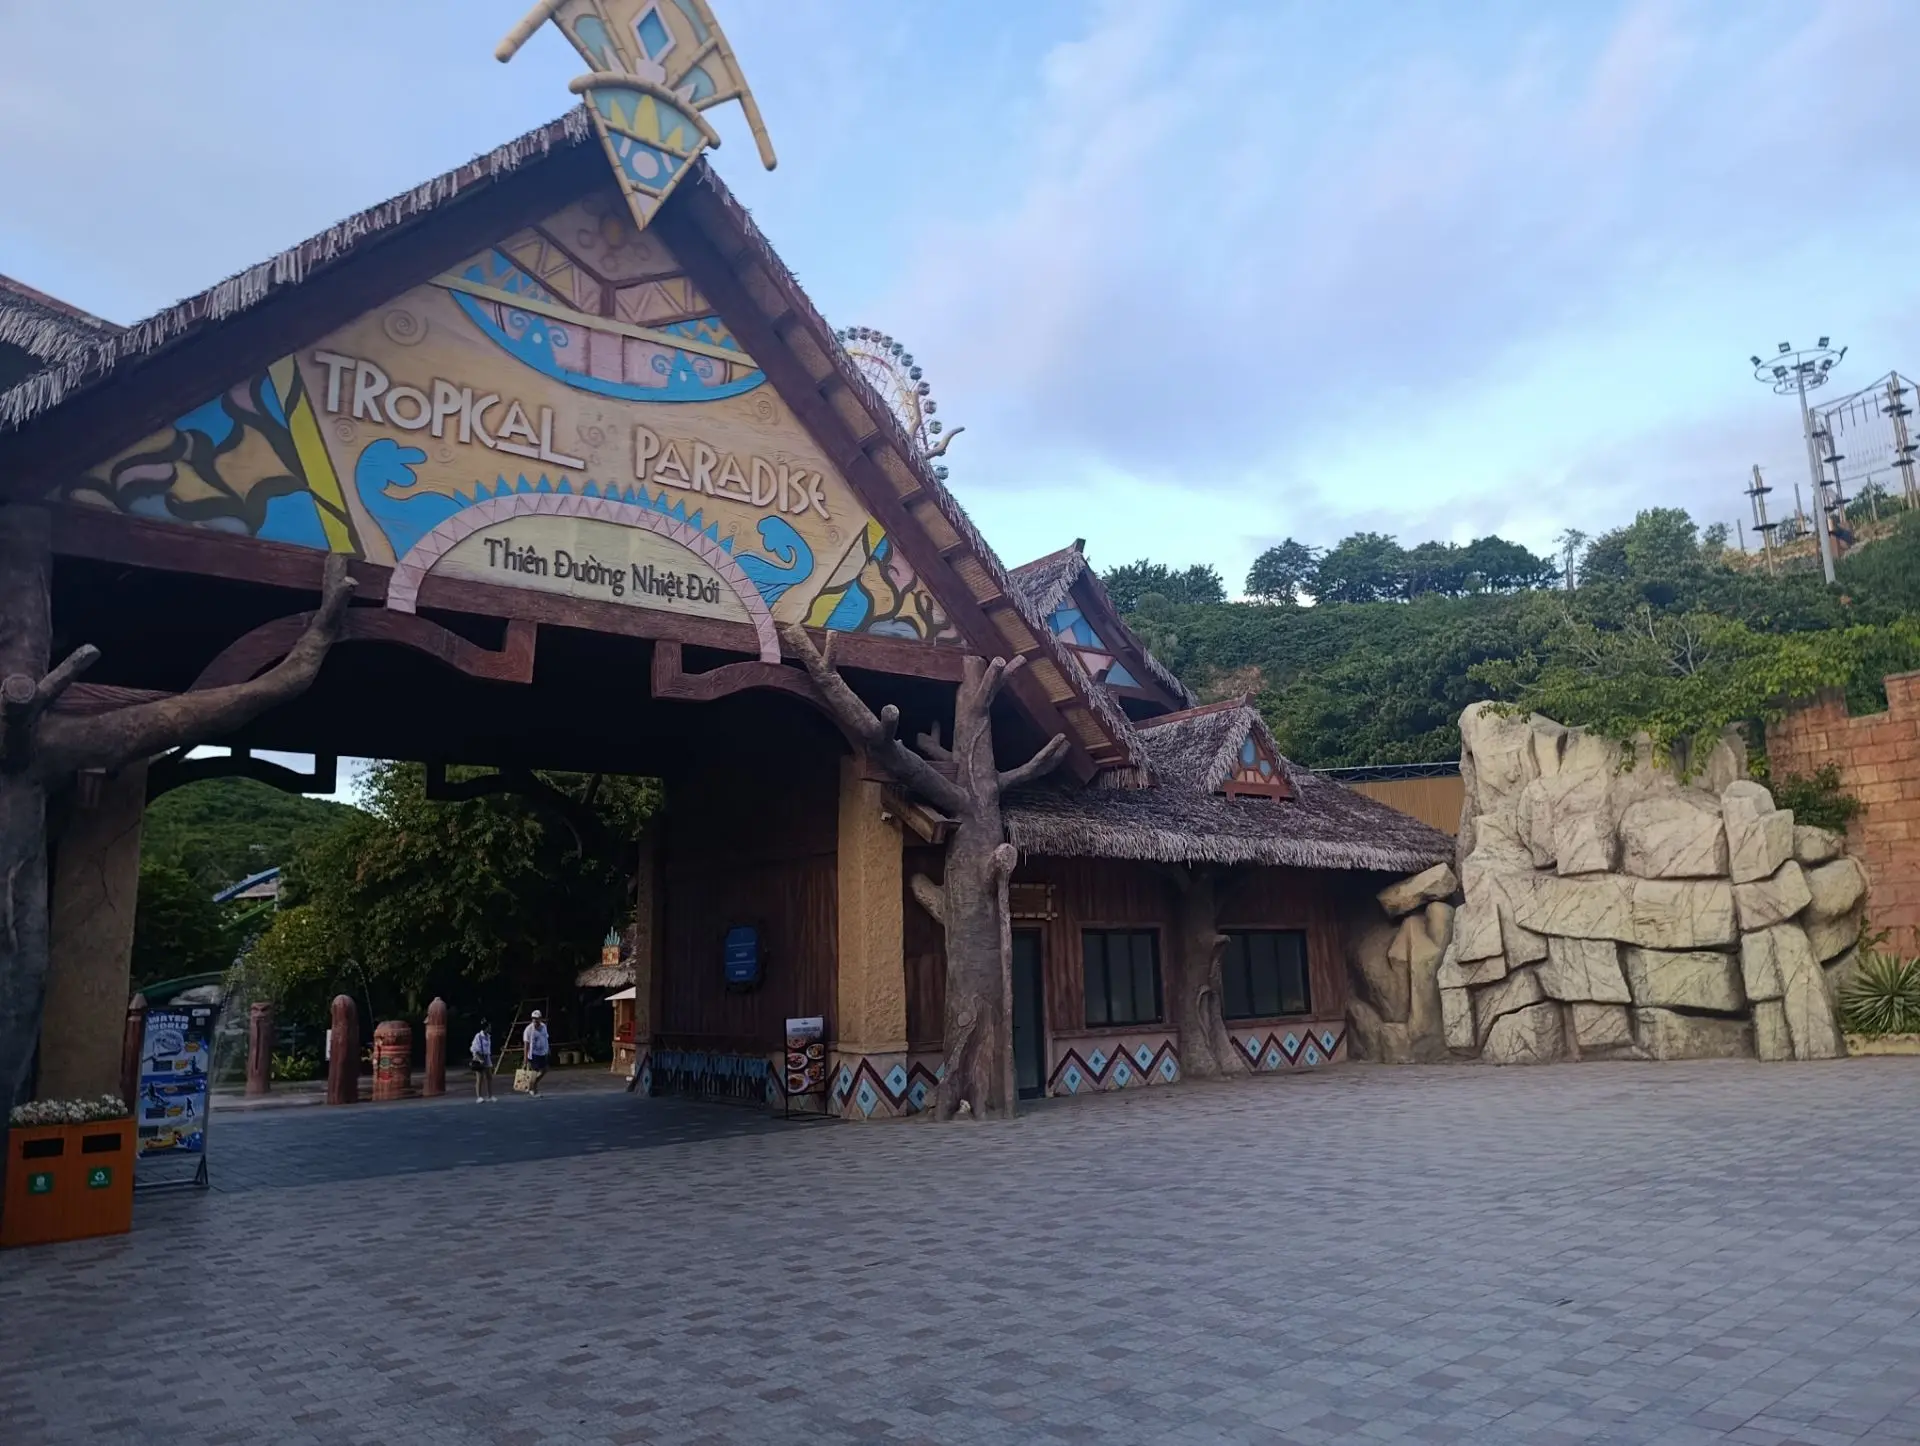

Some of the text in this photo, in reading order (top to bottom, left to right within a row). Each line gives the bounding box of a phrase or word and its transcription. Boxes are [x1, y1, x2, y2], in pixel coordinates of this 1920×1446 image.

[315, 350, 831, 520] TROPICAL PARADISE
[484, 537, 720, 604] Thiên Đường Nhiệt Đới
[148, 1015, 189, 1024] WATER
[148, 1022, 188, 1031] WORLD
